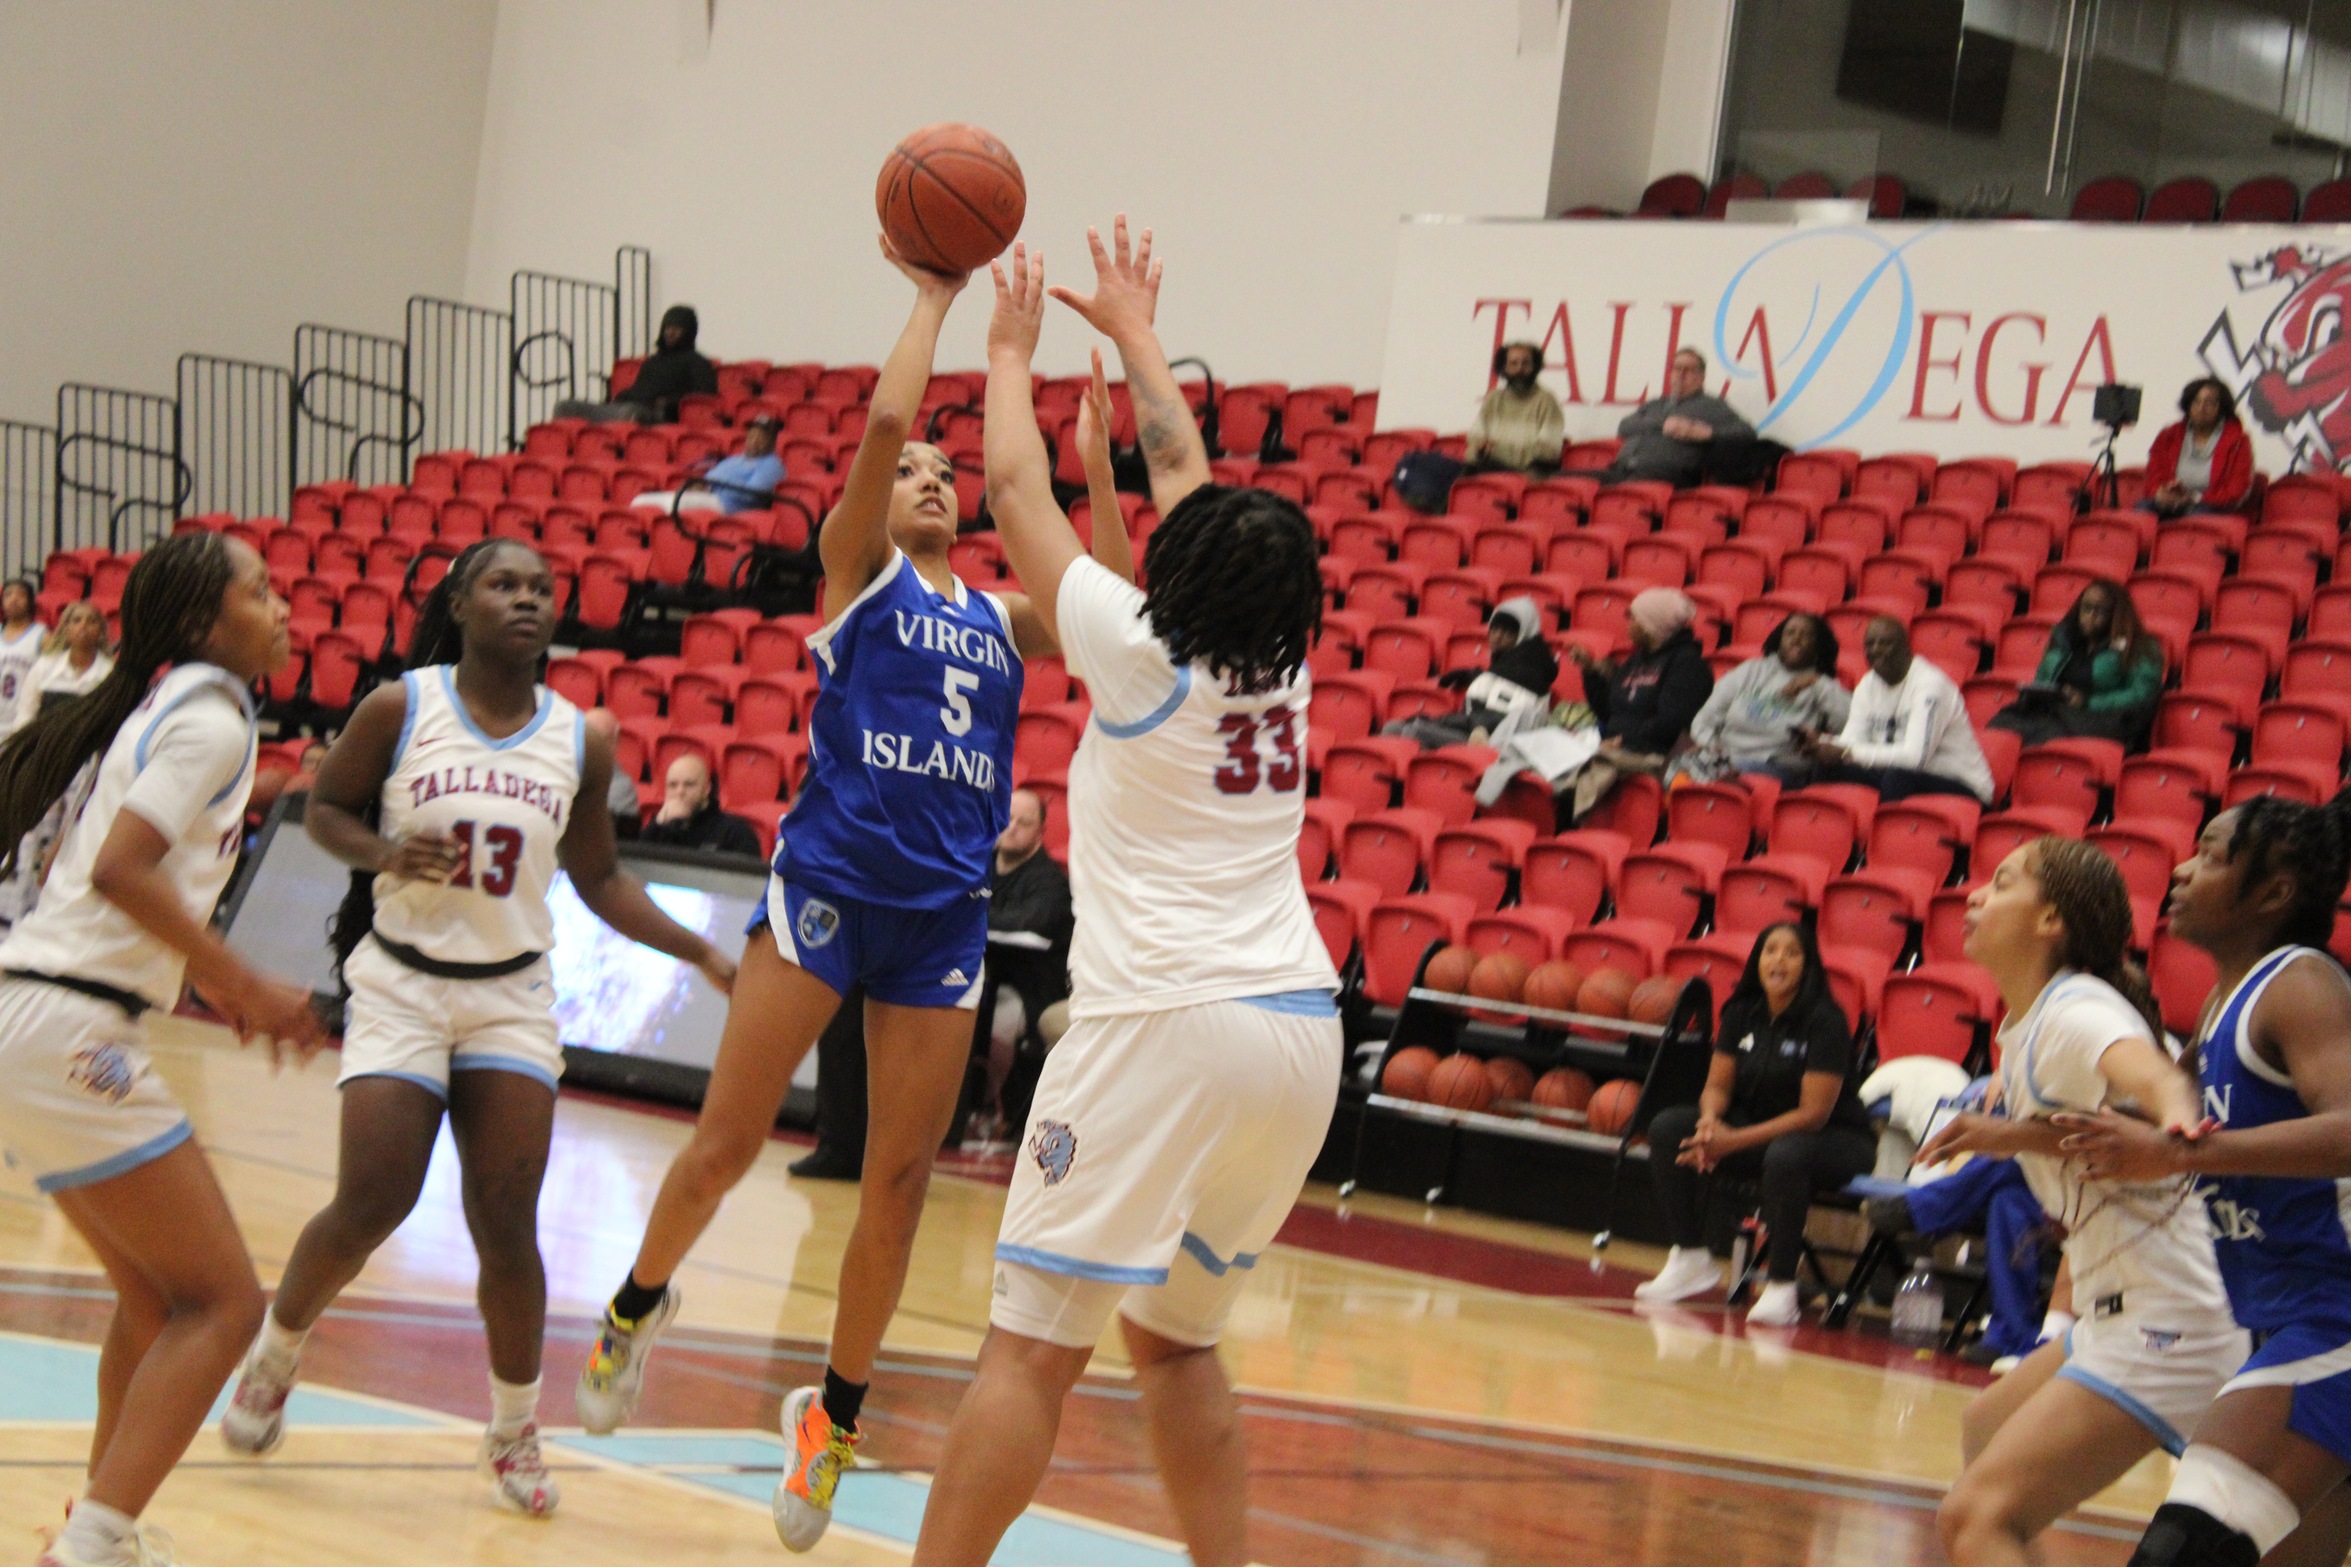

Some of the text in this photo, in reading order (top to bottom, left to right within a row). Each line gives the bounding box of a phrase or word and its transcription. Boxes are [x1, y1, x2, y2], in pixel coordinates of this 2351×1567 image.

[895, 609, 1010, 678] VIRGIN
[940, 664, 979, 737] 5
[1213, 703, 1300, 796] 33
[451, 819, 524, 898] 13
